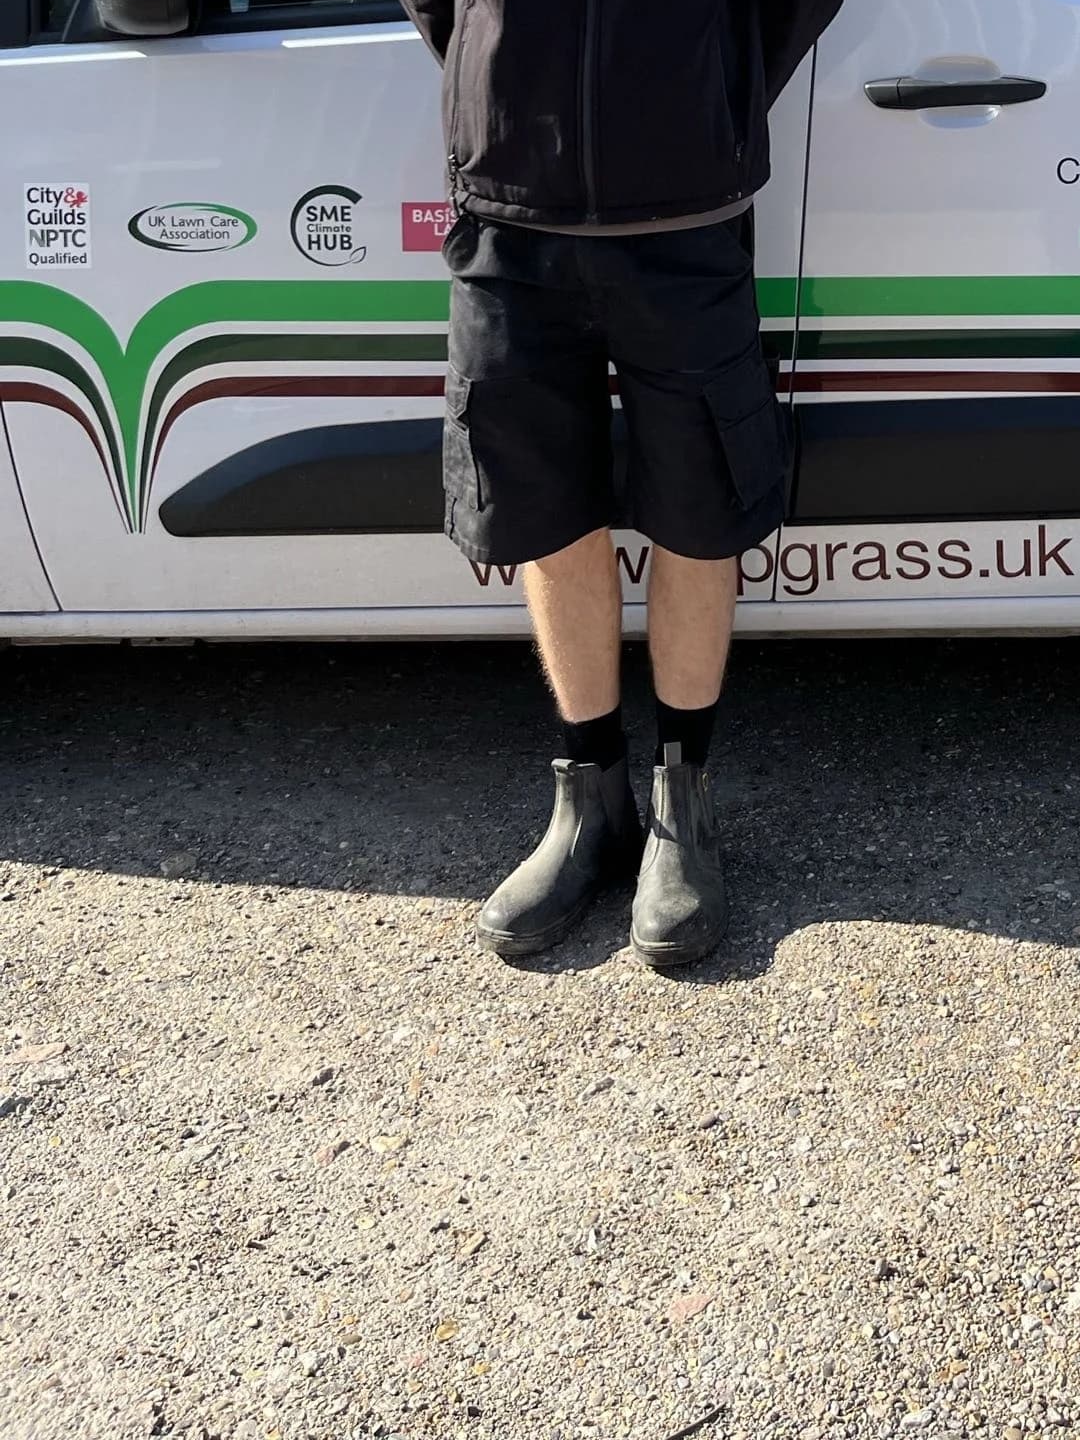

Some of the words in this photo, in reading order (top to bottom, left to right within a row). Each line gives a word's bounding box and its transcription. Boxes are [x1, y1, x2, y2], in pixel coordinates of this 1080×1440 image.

[27, 209, 86, 225] Guilds
[148, 216, 165, 227] UK
[171, 216, 204, 227] Lawn
[210, 216, 239, 227] Care
[306, 206, 352, 222] SME
[159, 229, 230, 240] Association
[307, 223, 352, 233] Climate
[29, 229, 86, 247] NPTC
[308, 234, 353, 250] HUB
[29, 252, 87, 266] Qualified
